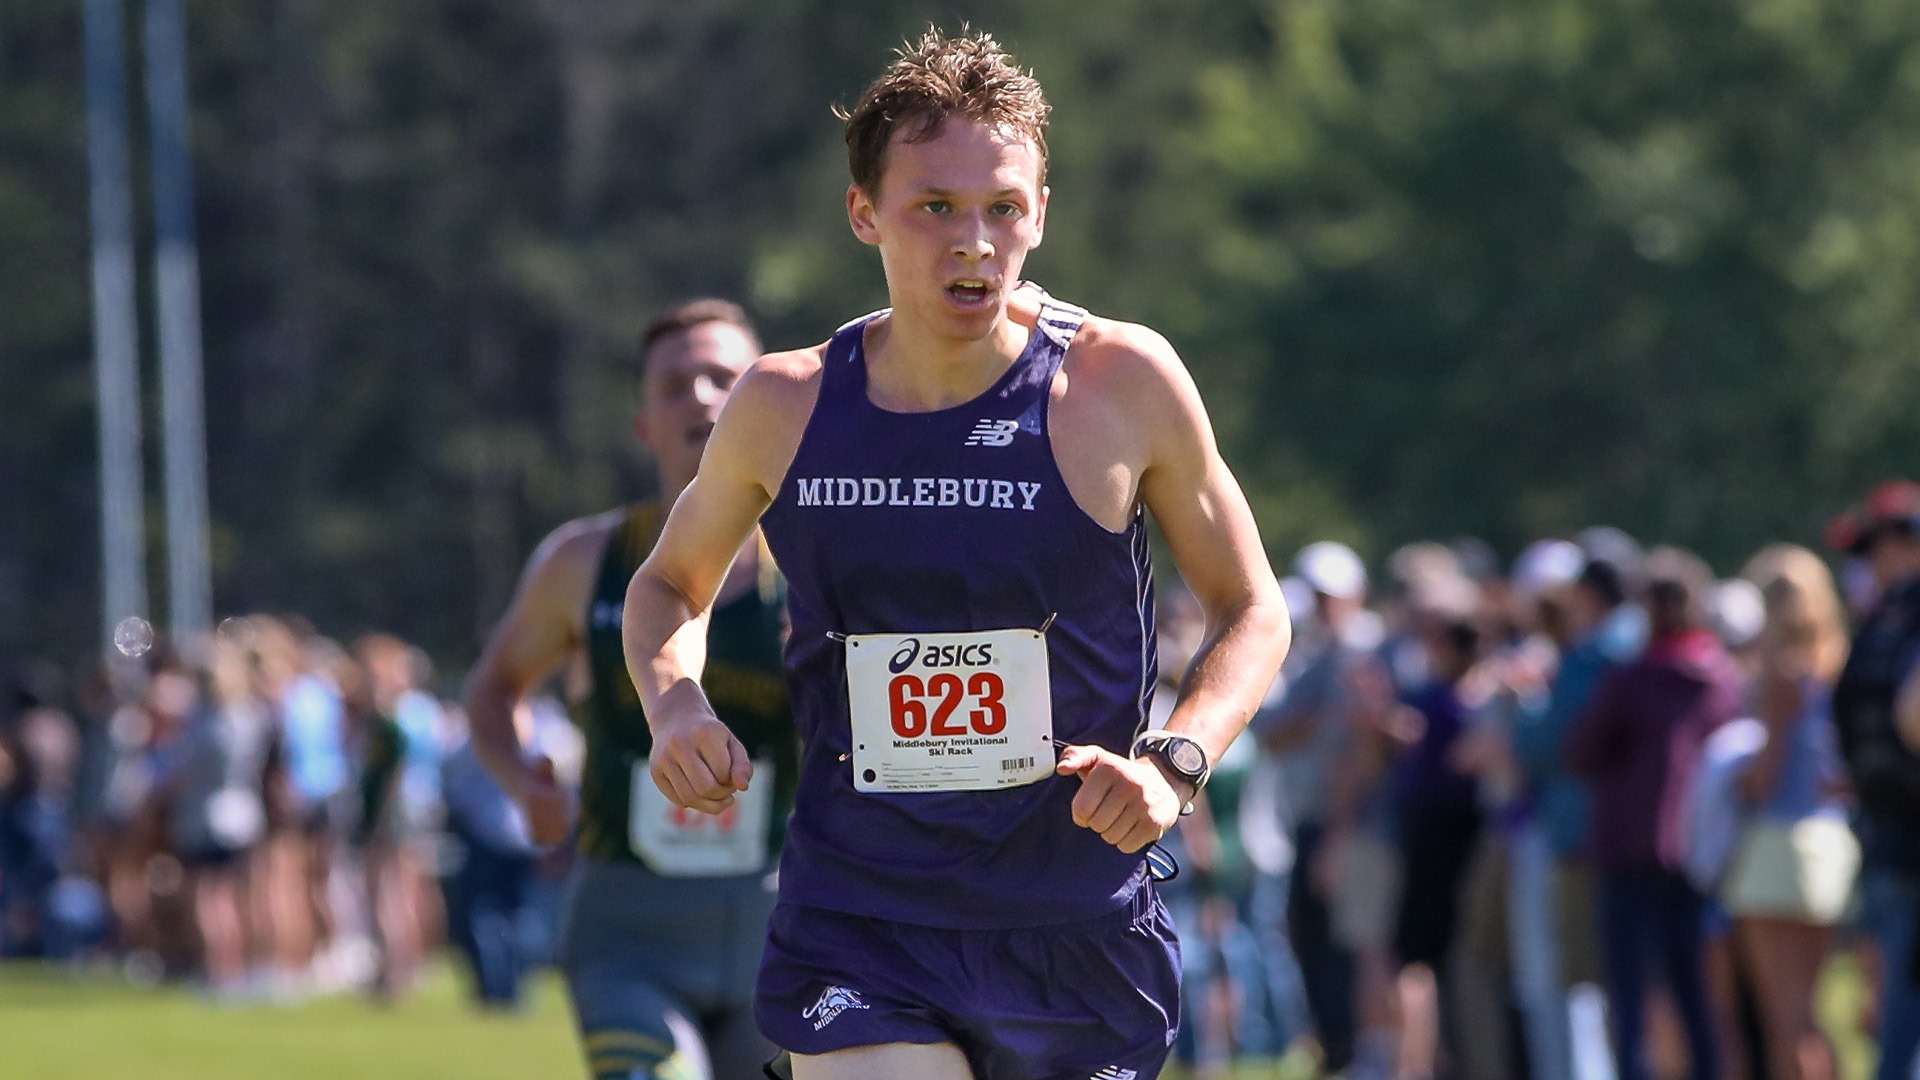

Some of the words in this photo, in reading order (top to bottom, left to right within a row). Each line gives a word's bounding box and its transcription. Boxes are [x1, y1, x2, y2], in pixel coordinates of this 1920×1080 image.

[797, 478, 1041, 510] MIDDLEBURY
[888, 672, 1007, 738] 623
[893, 739, 947, 748] Middlebury
[951, 737, 1008, 746] Invitational
[928, 748, 944, 757] Ski
[948, 748, 973, 756] Rack
